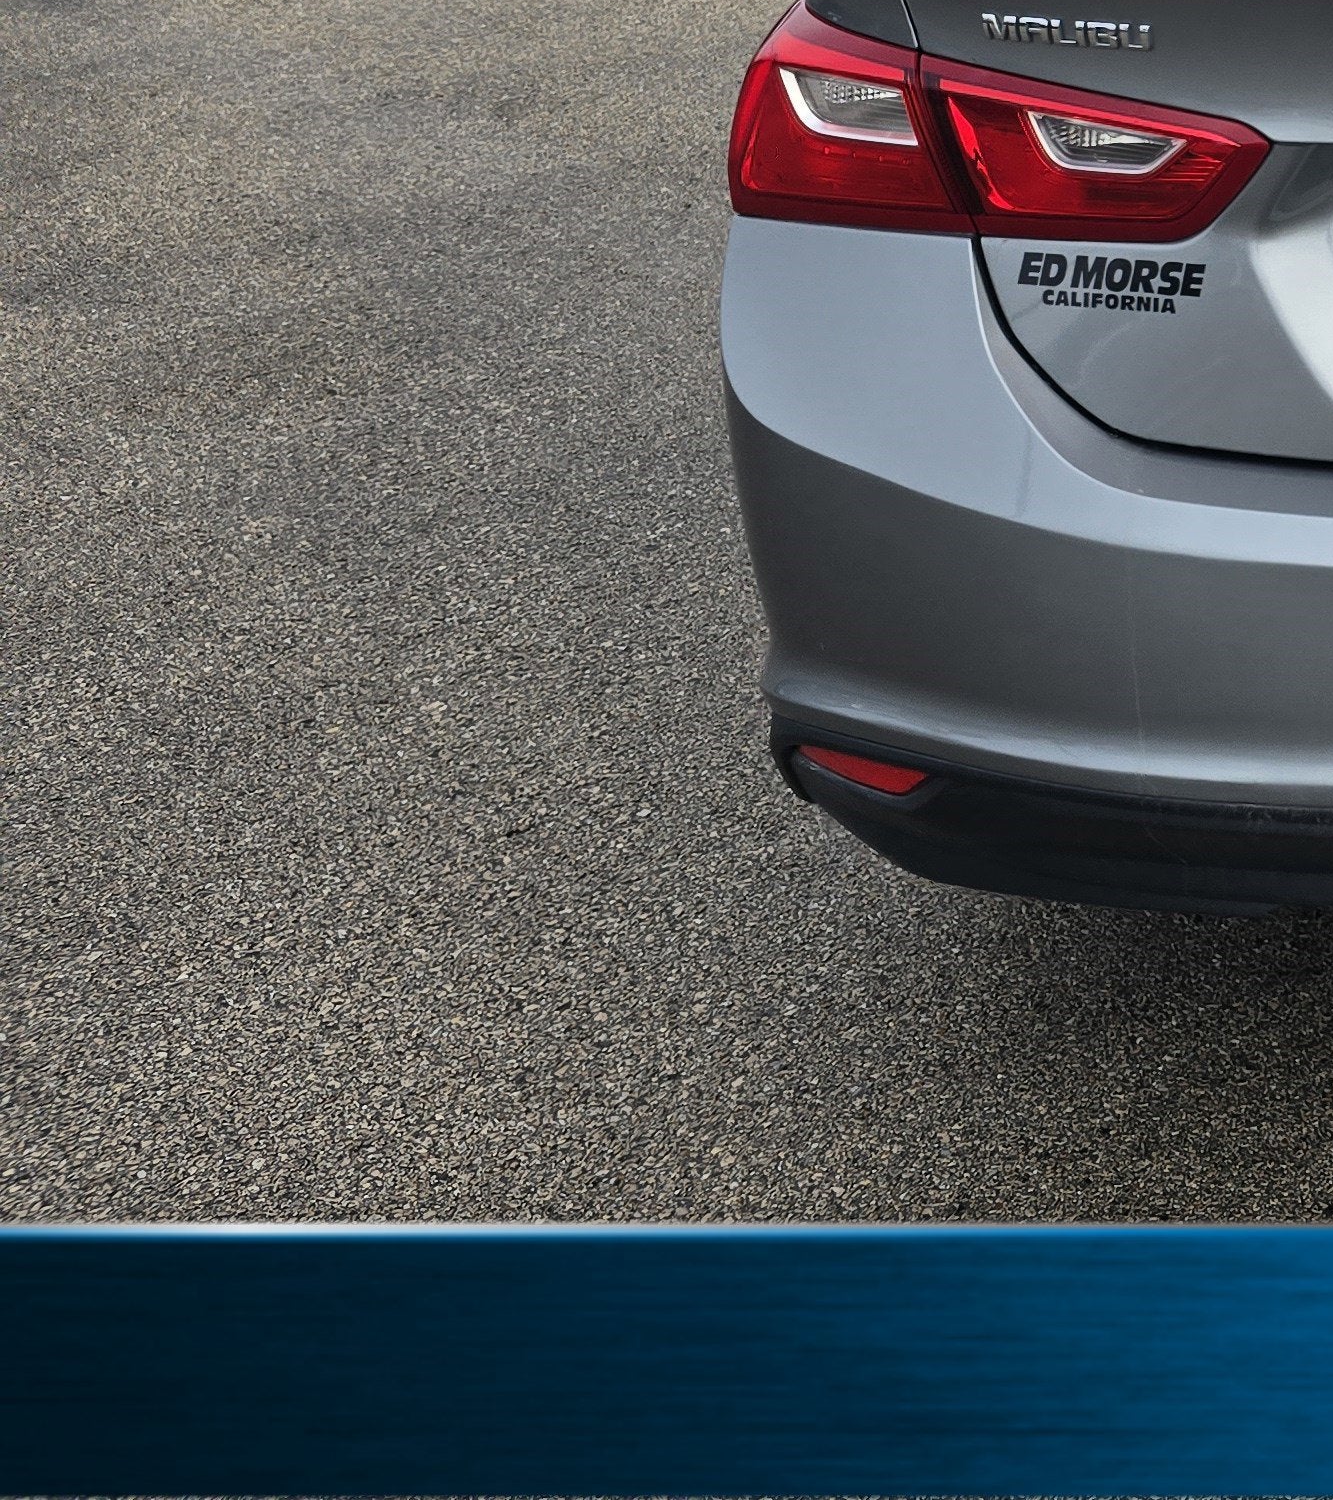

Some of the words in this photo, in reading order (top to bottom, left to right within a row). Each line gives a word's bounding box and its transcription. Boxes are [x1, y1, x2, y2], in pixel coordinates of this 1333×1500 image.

[981, 12, 1153, 49] MALIBU
[1017, 252, 1068, 286] ED
[1069, 255, 1207, 298] MORSE
[1042, 290, 1177, 315] CALIFORNIA
